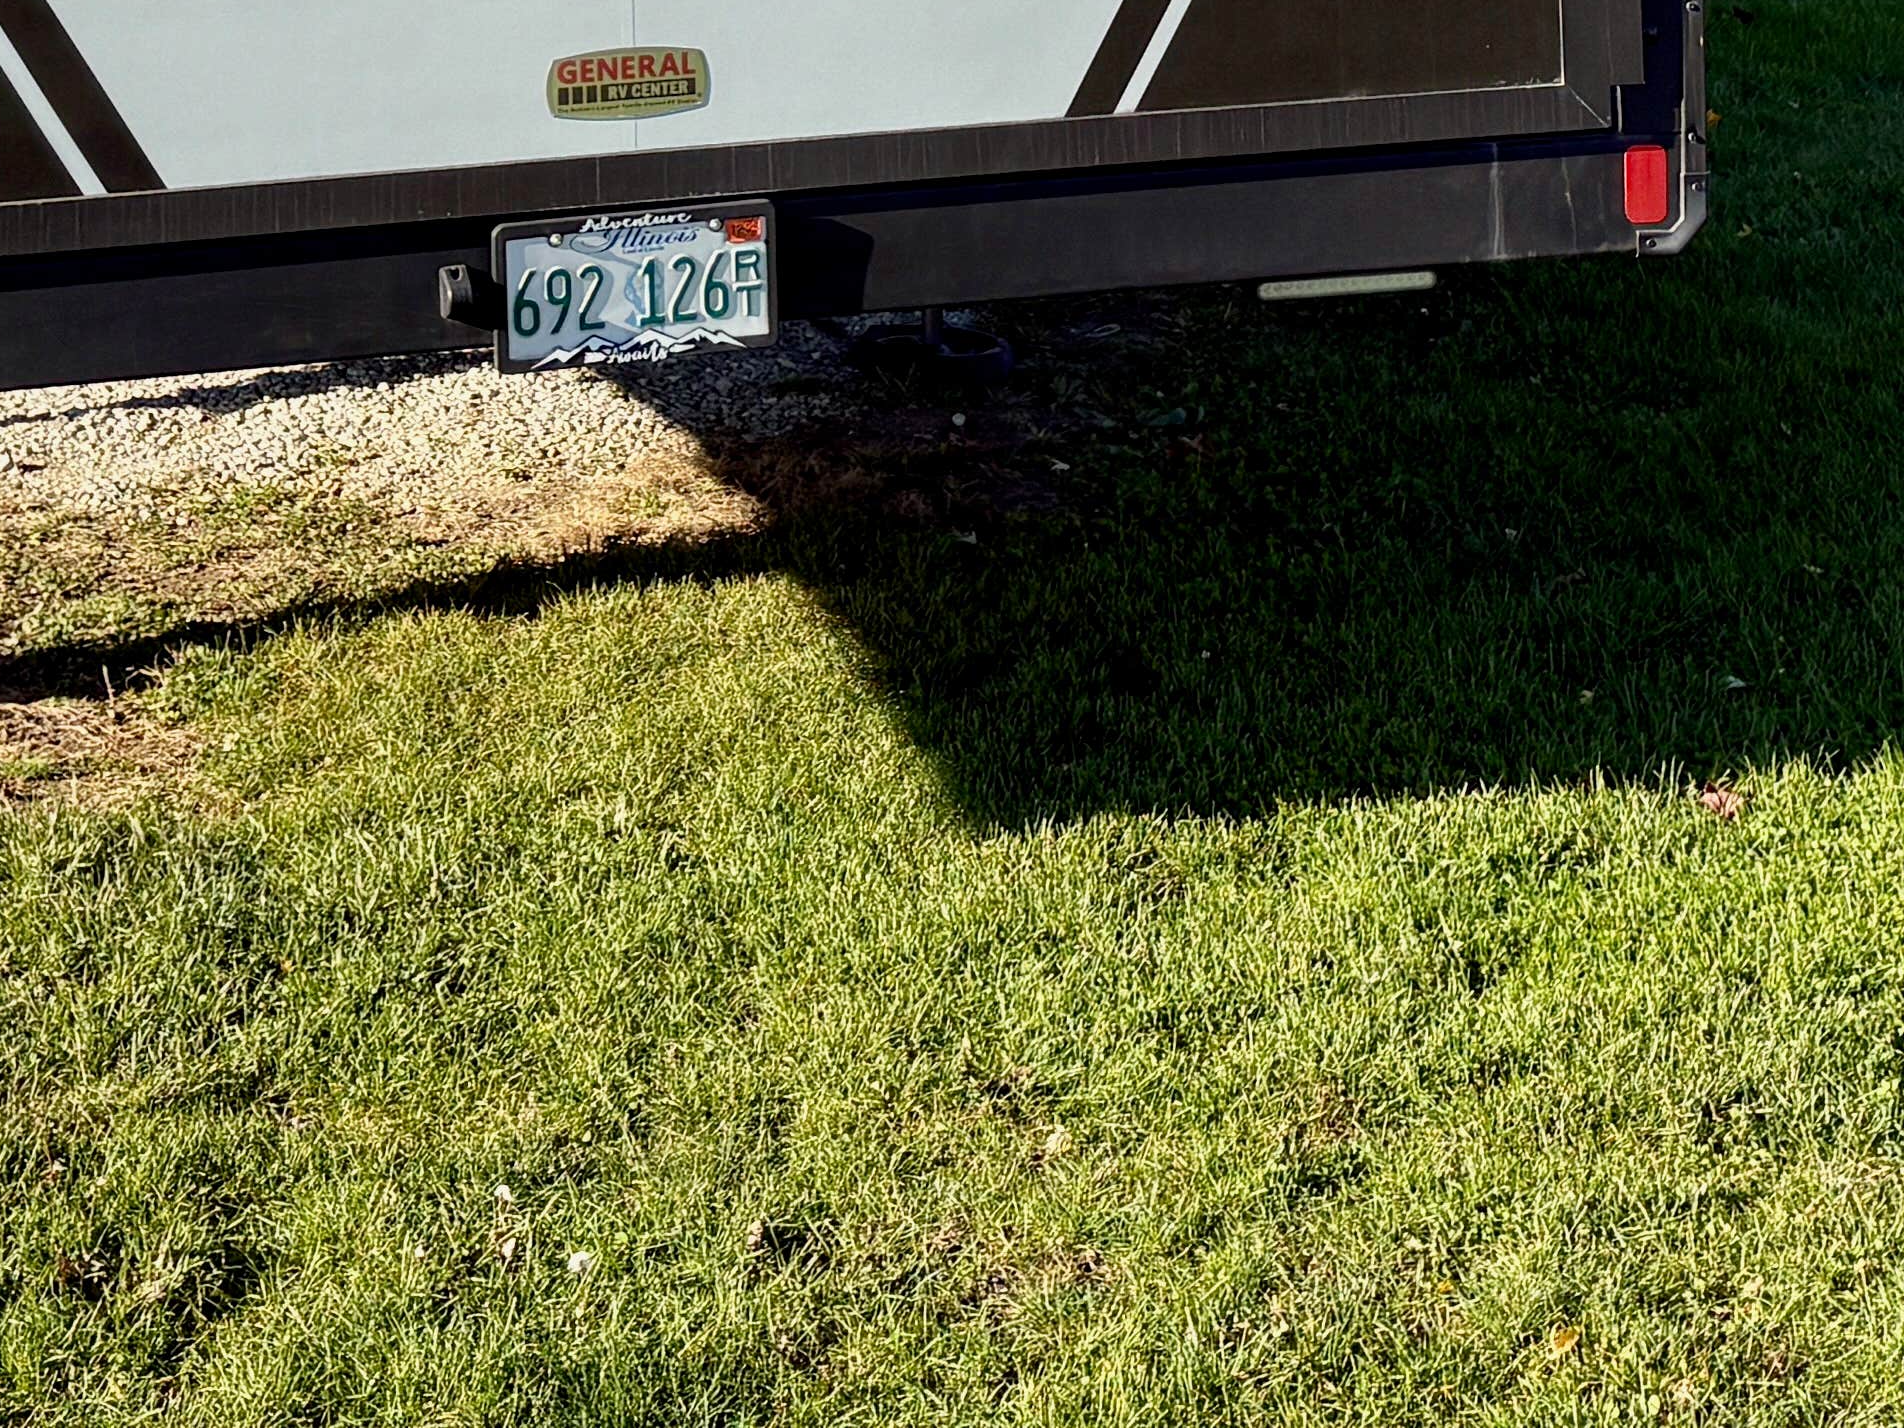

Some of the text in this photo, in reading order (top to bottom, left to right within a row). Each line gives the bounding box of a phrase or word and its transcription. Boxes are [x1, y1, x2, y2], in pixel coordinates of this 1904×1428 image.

[556, 51, 696, 84] GENERAL
[607, 80, 689, 100] RV CENTER
[579, 213, 692, 232] Adventure
[513, 263, 605, 336] 692
[636, 249, 728, 329] 126
